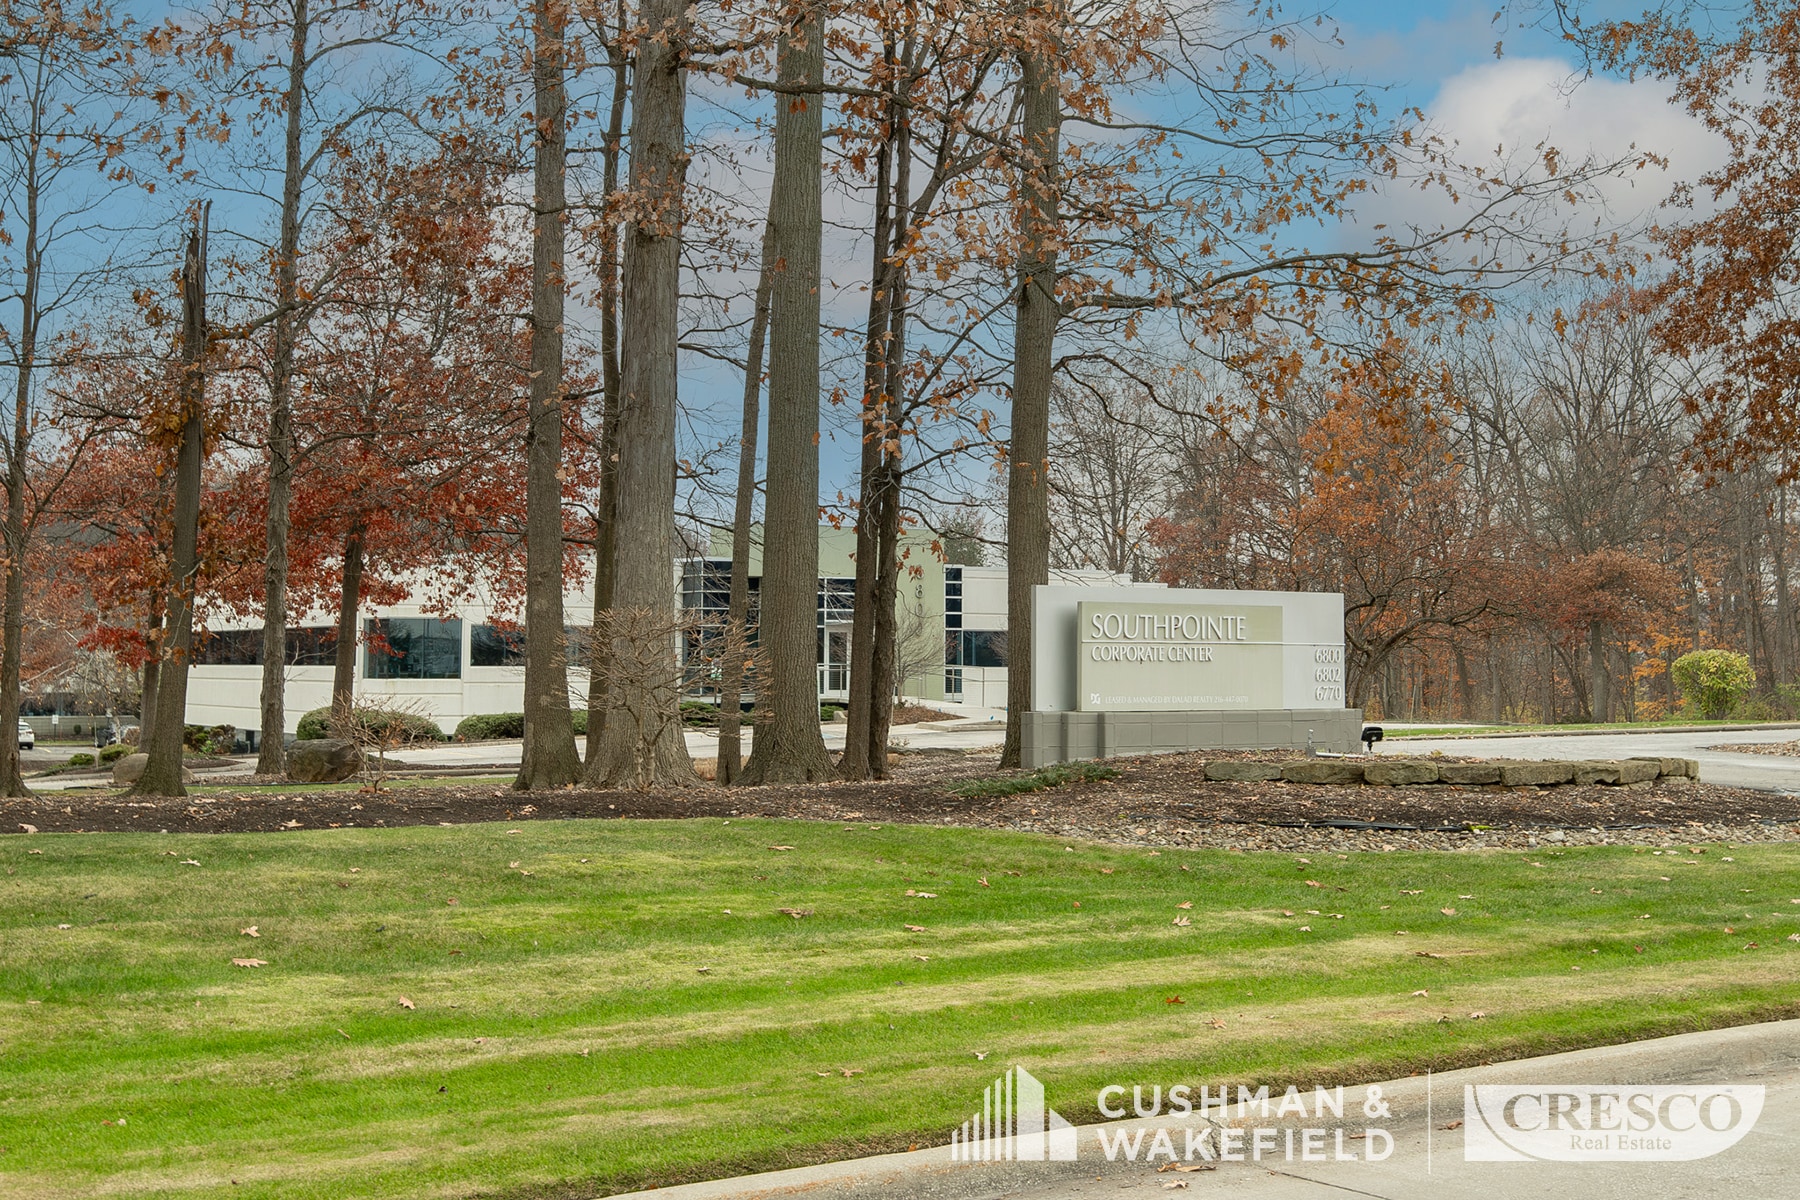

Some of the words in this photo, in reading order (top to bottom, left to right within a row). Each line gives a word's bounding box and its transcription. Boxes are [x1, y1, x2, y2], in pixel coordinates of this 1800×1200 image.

[1091, 613, 1247, 640] SOUTHPOINTE
[1091, 646, 1165, 662] CORPORATE
[1167, 647, 1213, 662] CENTER
[1315, 648, 1342, 663] 6800
[1315, 667, 1342, 682] 6802
[1105, 695, 1127, 704] LEASED
[1127, 695, 1132, 704] &
[1133, 695, 1163, 704] MANAGED
[1163, 695, 1171, 704] BY
[1193, 695, 1213, 704] REALTY
[1315, 686, 1342, 700] 6770
